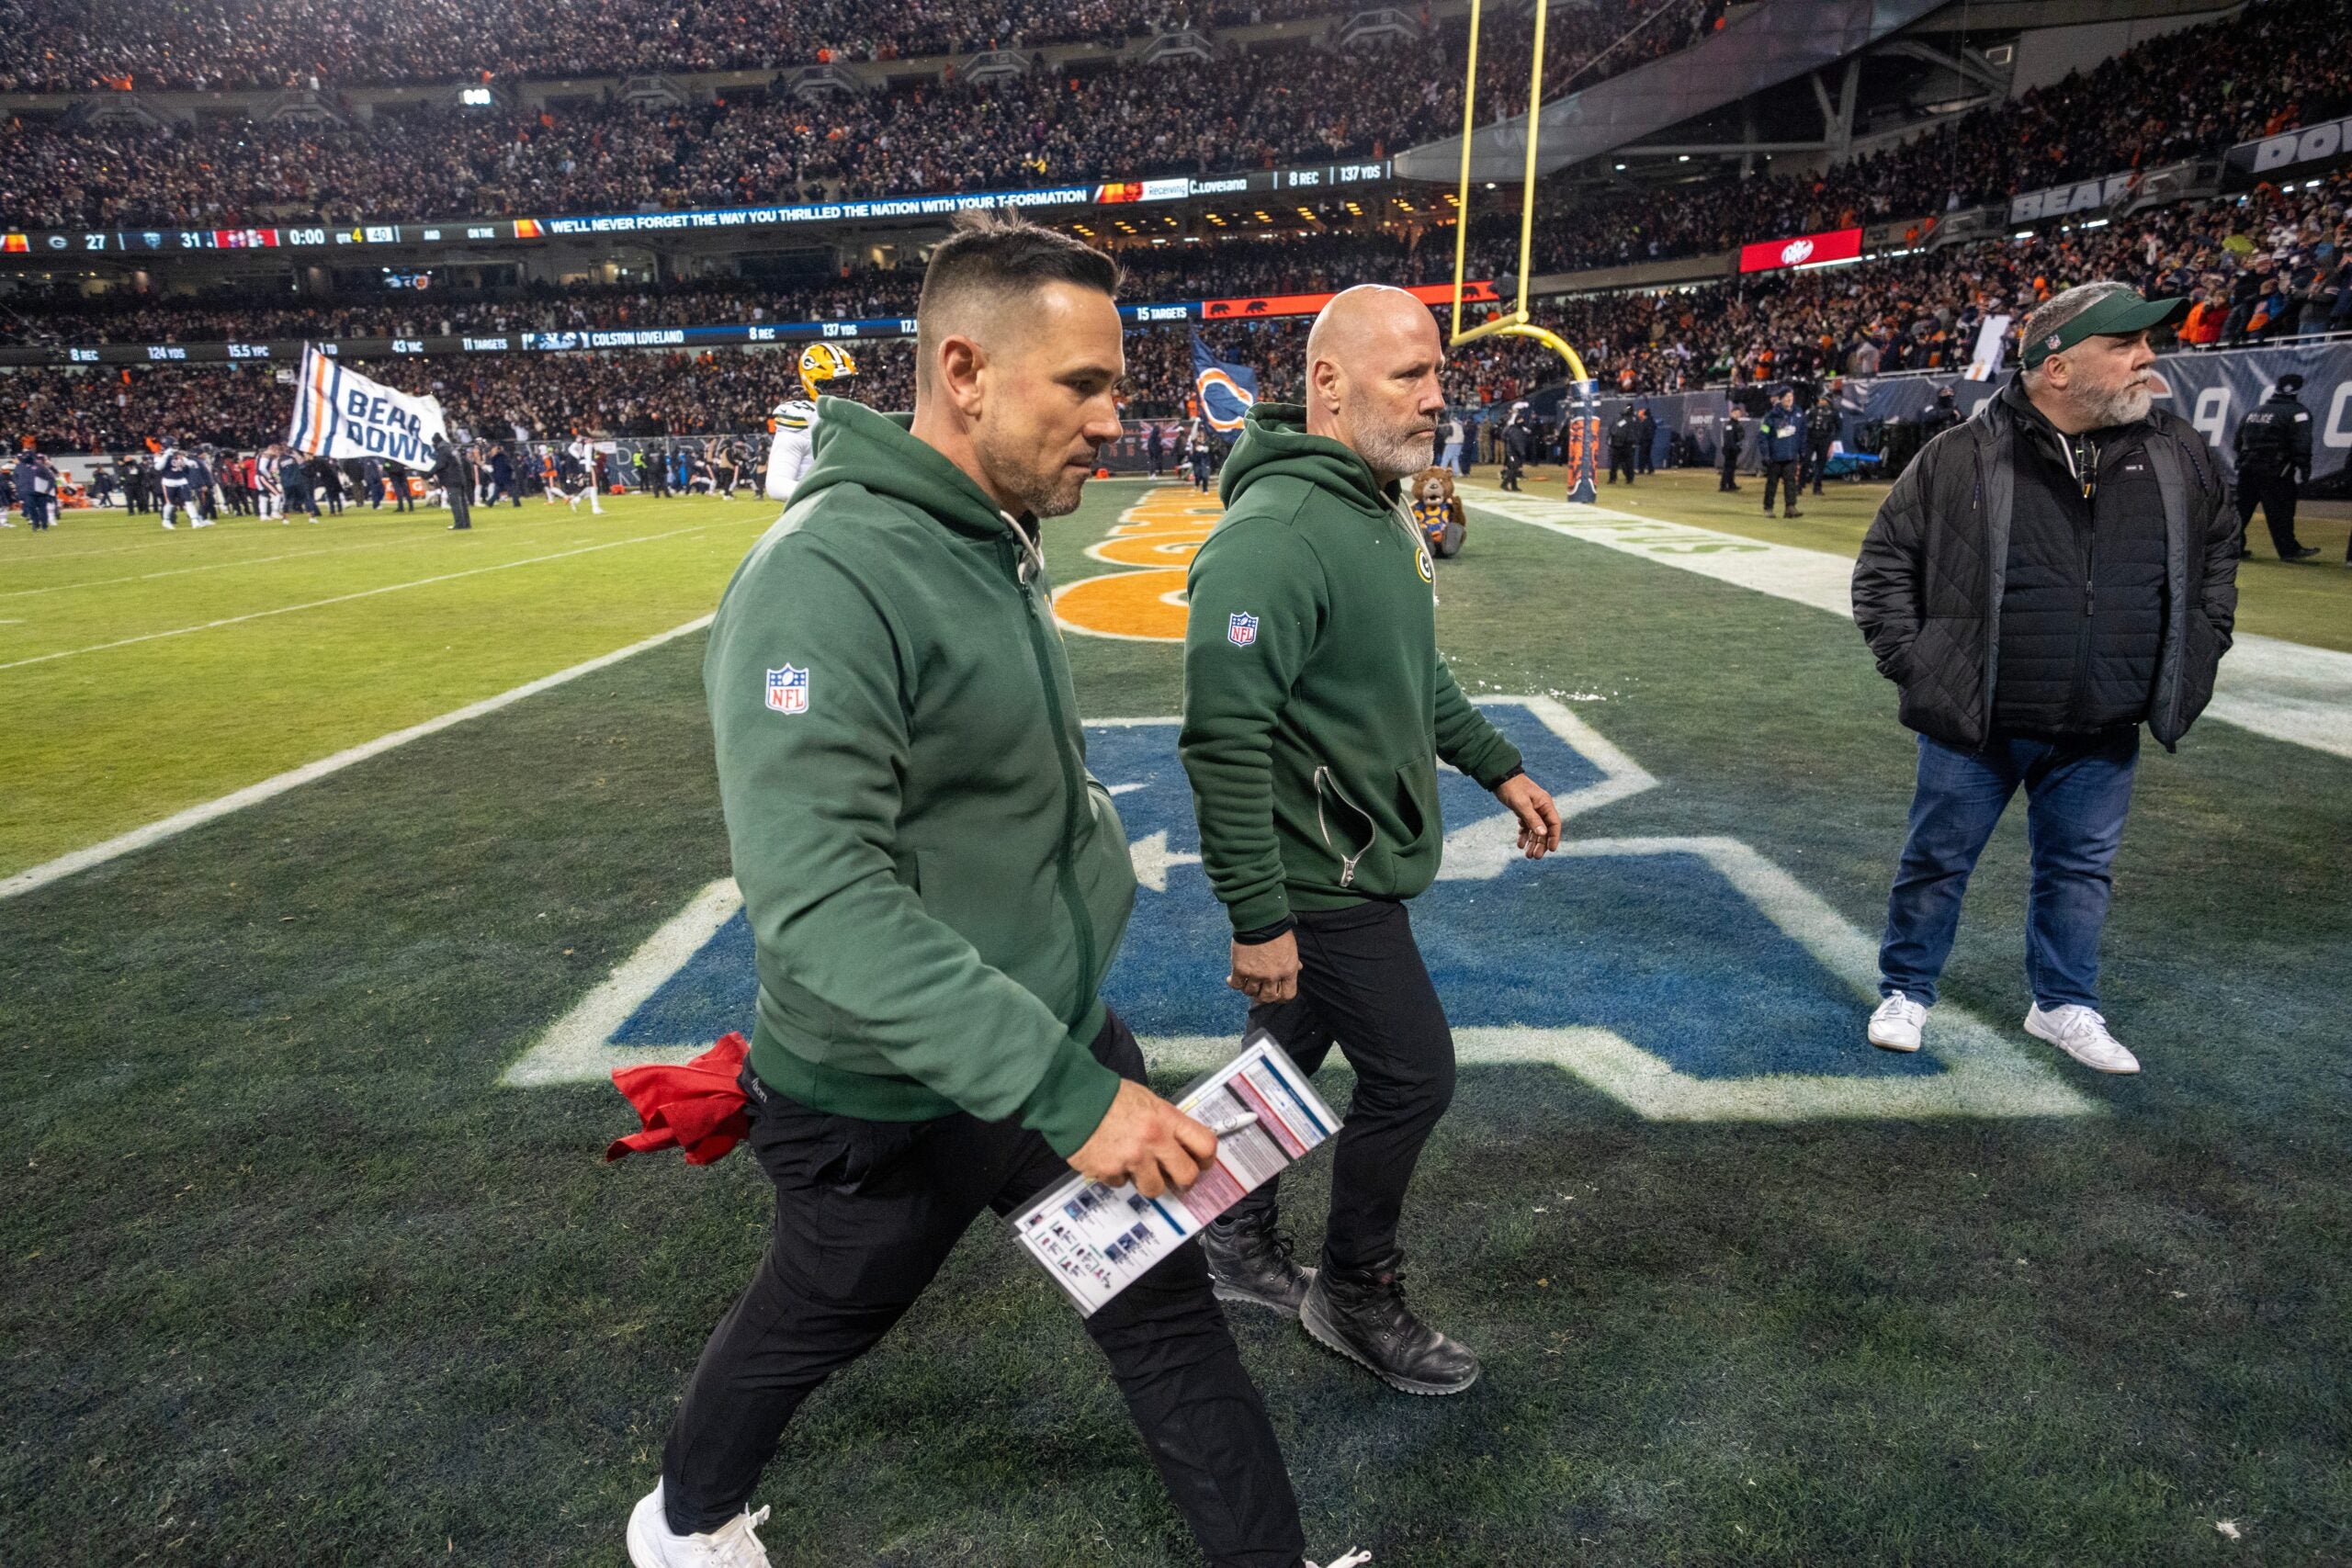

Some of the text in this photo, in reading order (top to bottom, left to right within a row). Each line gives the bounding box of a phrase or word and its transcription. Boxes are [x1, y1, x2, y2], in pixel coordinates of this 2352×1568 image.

[2254, 120, 2352, 174] DO
[1289, 171, 1319, 186] 8 REC
[1340, 165, 1381, 182] 137 YDS
[550, 189, 1087, 233] WE'LL NEVER FORGET THE WAY YOU THRILLED THE NATION WITH YOUR T-FORMATION
[85, 234, 106, 250] 27
[181, 232, 201, 248] 31
[289, 229, 325, 244] 0:00
[352, 228, 363, 243] 4
[1136, 307, 1187, 321] 15 TARGETS
[749, 327, 775, 340] 8 REC
[821, 322, 857, 337] 137 YDS
[462, 338, 508, 351] 11 TARGETS
[592, 330, 684, 346] COLSTON LOVELAND
[148, 346, 187, 359] 124 YDS
[228, 344, 269, 357] 15.5 YPC
[391, 340, 406, 353] 43
[71, 348, 98, 361] 8 REC
[1233, 626, 1253, 642] NFL
[772, 689, 804, 708] NFL
